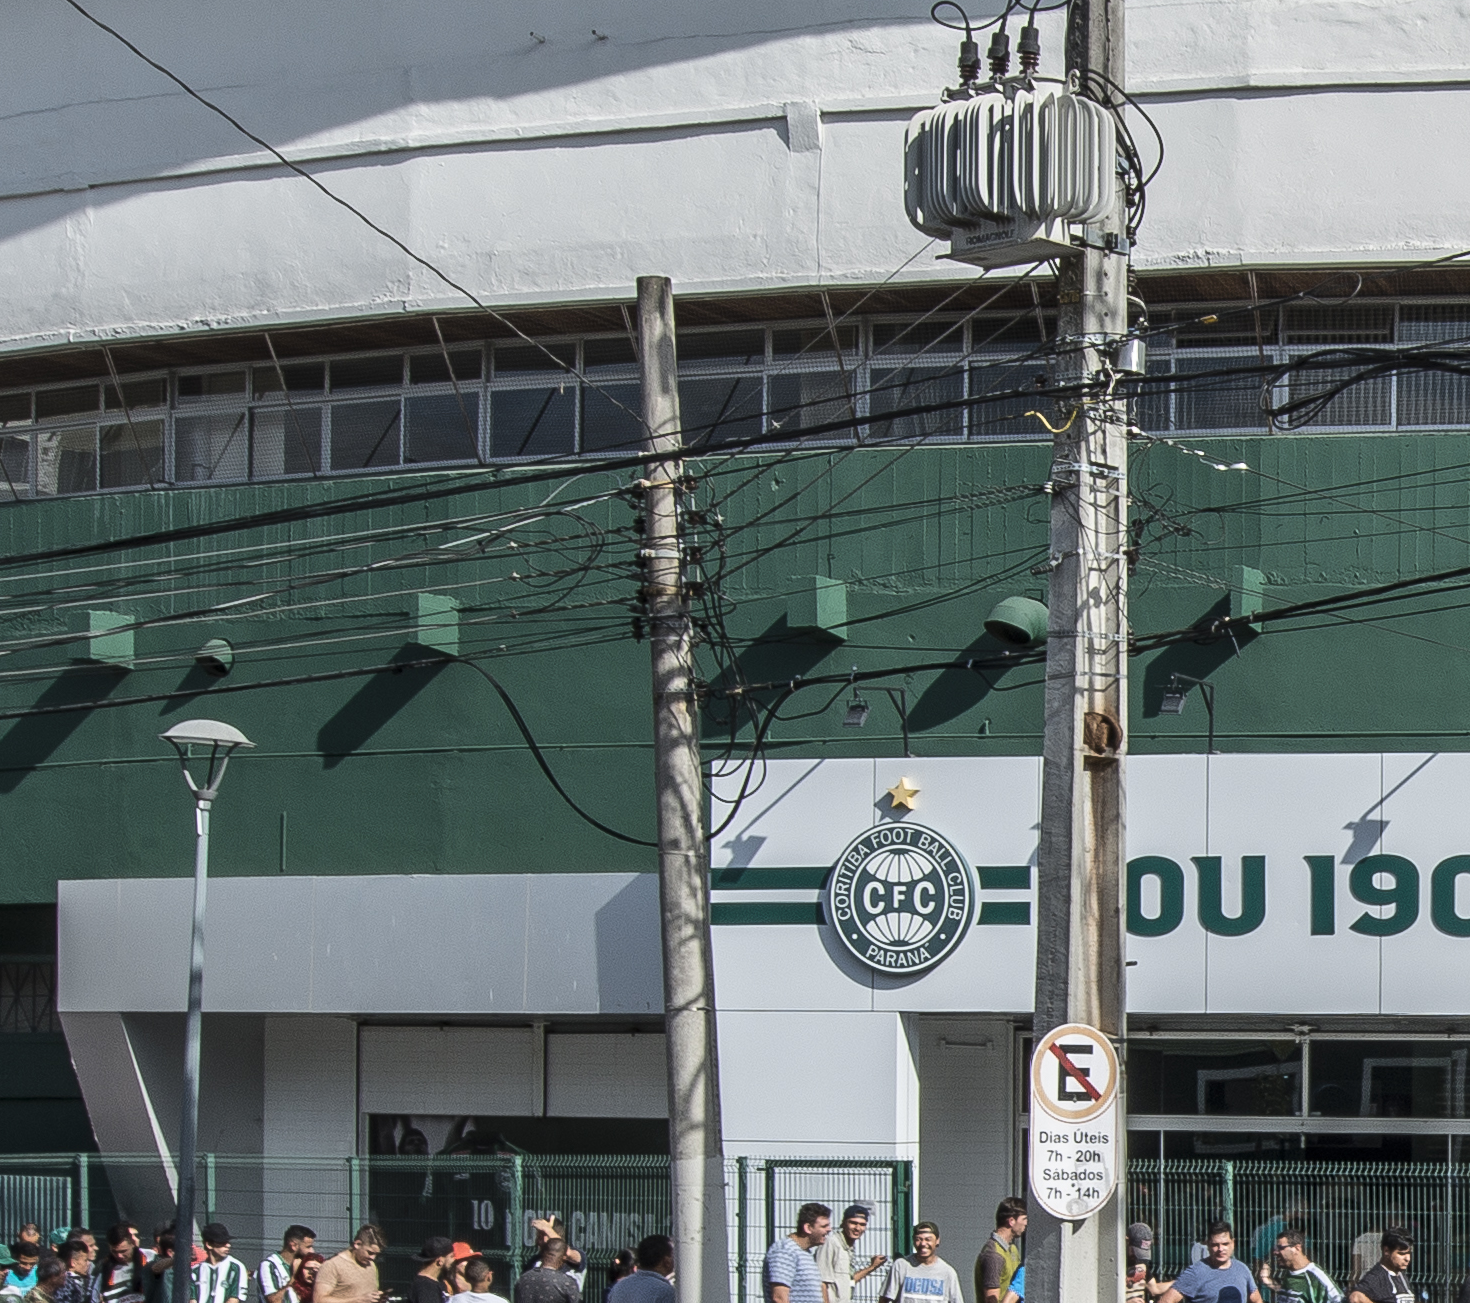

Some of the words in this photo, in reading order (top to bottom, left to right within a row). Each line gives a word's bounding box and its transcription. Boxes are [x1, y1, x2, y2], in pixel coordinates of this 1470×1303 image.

[835, 844, 871, 920] CORITIBA
[870, 828, 916, 849] FOOT
[917, 834, 952, 870] BALL
[947, 872, 964, 920] CLUB
[863, 881, 936, 914] CFC
[1127, 855, 1267, 938] OU
[1058, 1044, 1094, 1101] E
[1039, 1131, 1069, 1144] Dias
[1073, 1128, 1109, 1144] Úteis
[1046, 1150, 1063, 1162] 7h
[1075, 1150, 1101, 1162] 20h
[1043, 1168, 1104, 1181] Sábados
[1046, 1187, 1062, 1199] 7h
[1075, 1187, 1100, 1199] 14h
